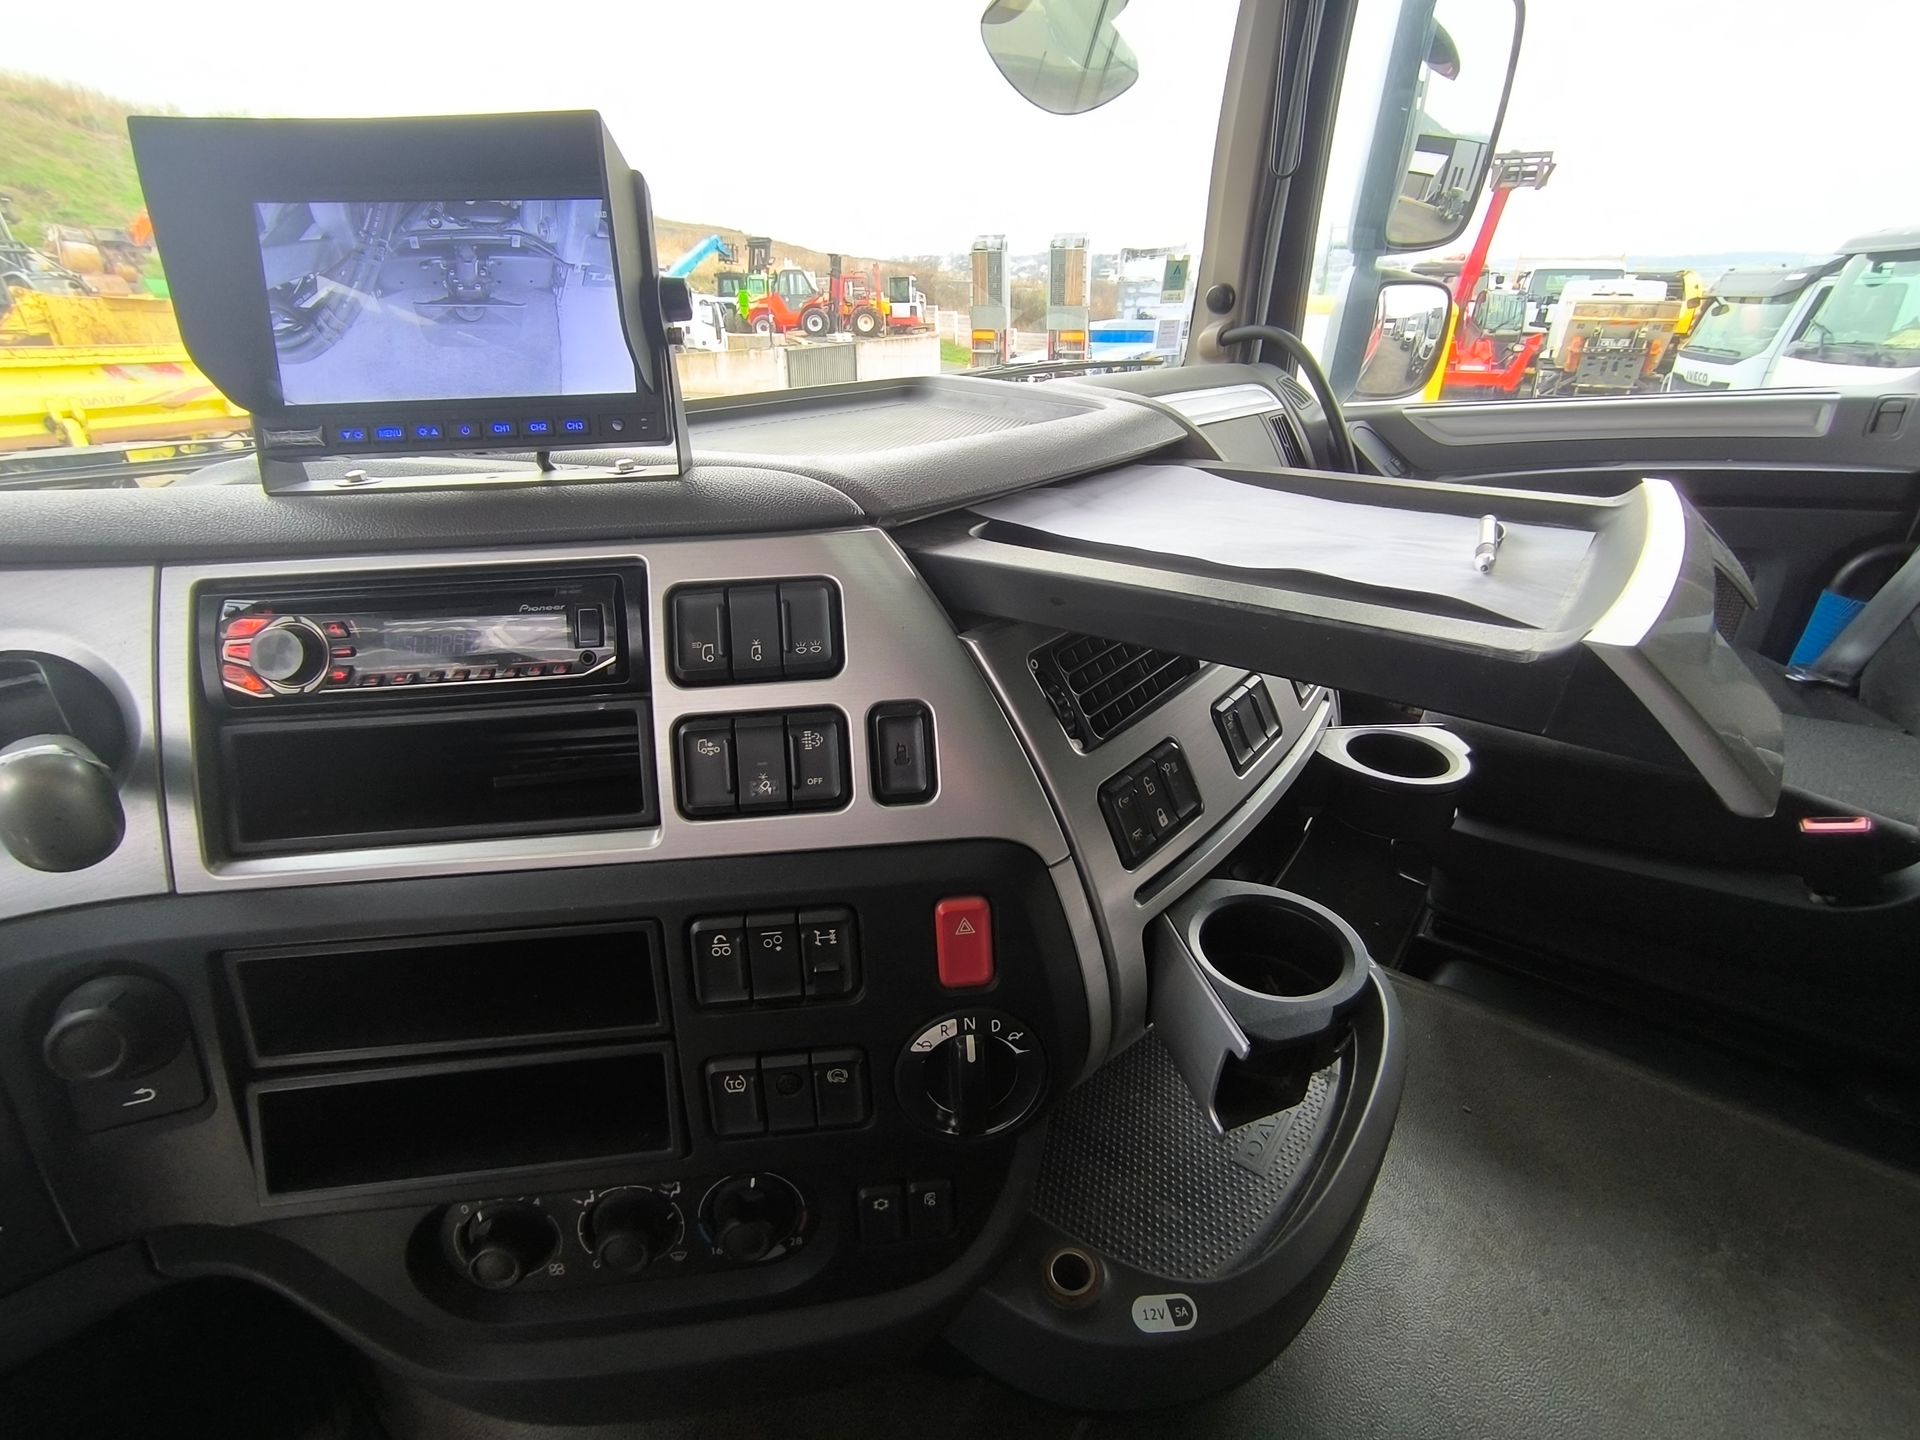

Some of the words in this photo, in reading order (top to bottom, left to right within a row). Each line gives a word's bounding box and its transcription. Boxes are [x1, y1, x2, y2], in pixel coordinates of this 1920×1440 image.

[1686, 370, 1708, 383] IVECO
[494, 424, 510, 433] CH1
[530, 423, 547, 431] CH2
[566, 421, 583, 430] CH3
[519, 604, 565, 612] Pioneer
[807, 777, 824, 785] OFF
[963, 1017, 976, 1031] N
[991, 1019, 1001, 1032] D
[940, 1024, 950, 1037] R
[728, 1079, 743, 1089] TC
[1142, 1307, 1165, 1321] 12V
[1174, 1306, 1189, 1318] 5A
